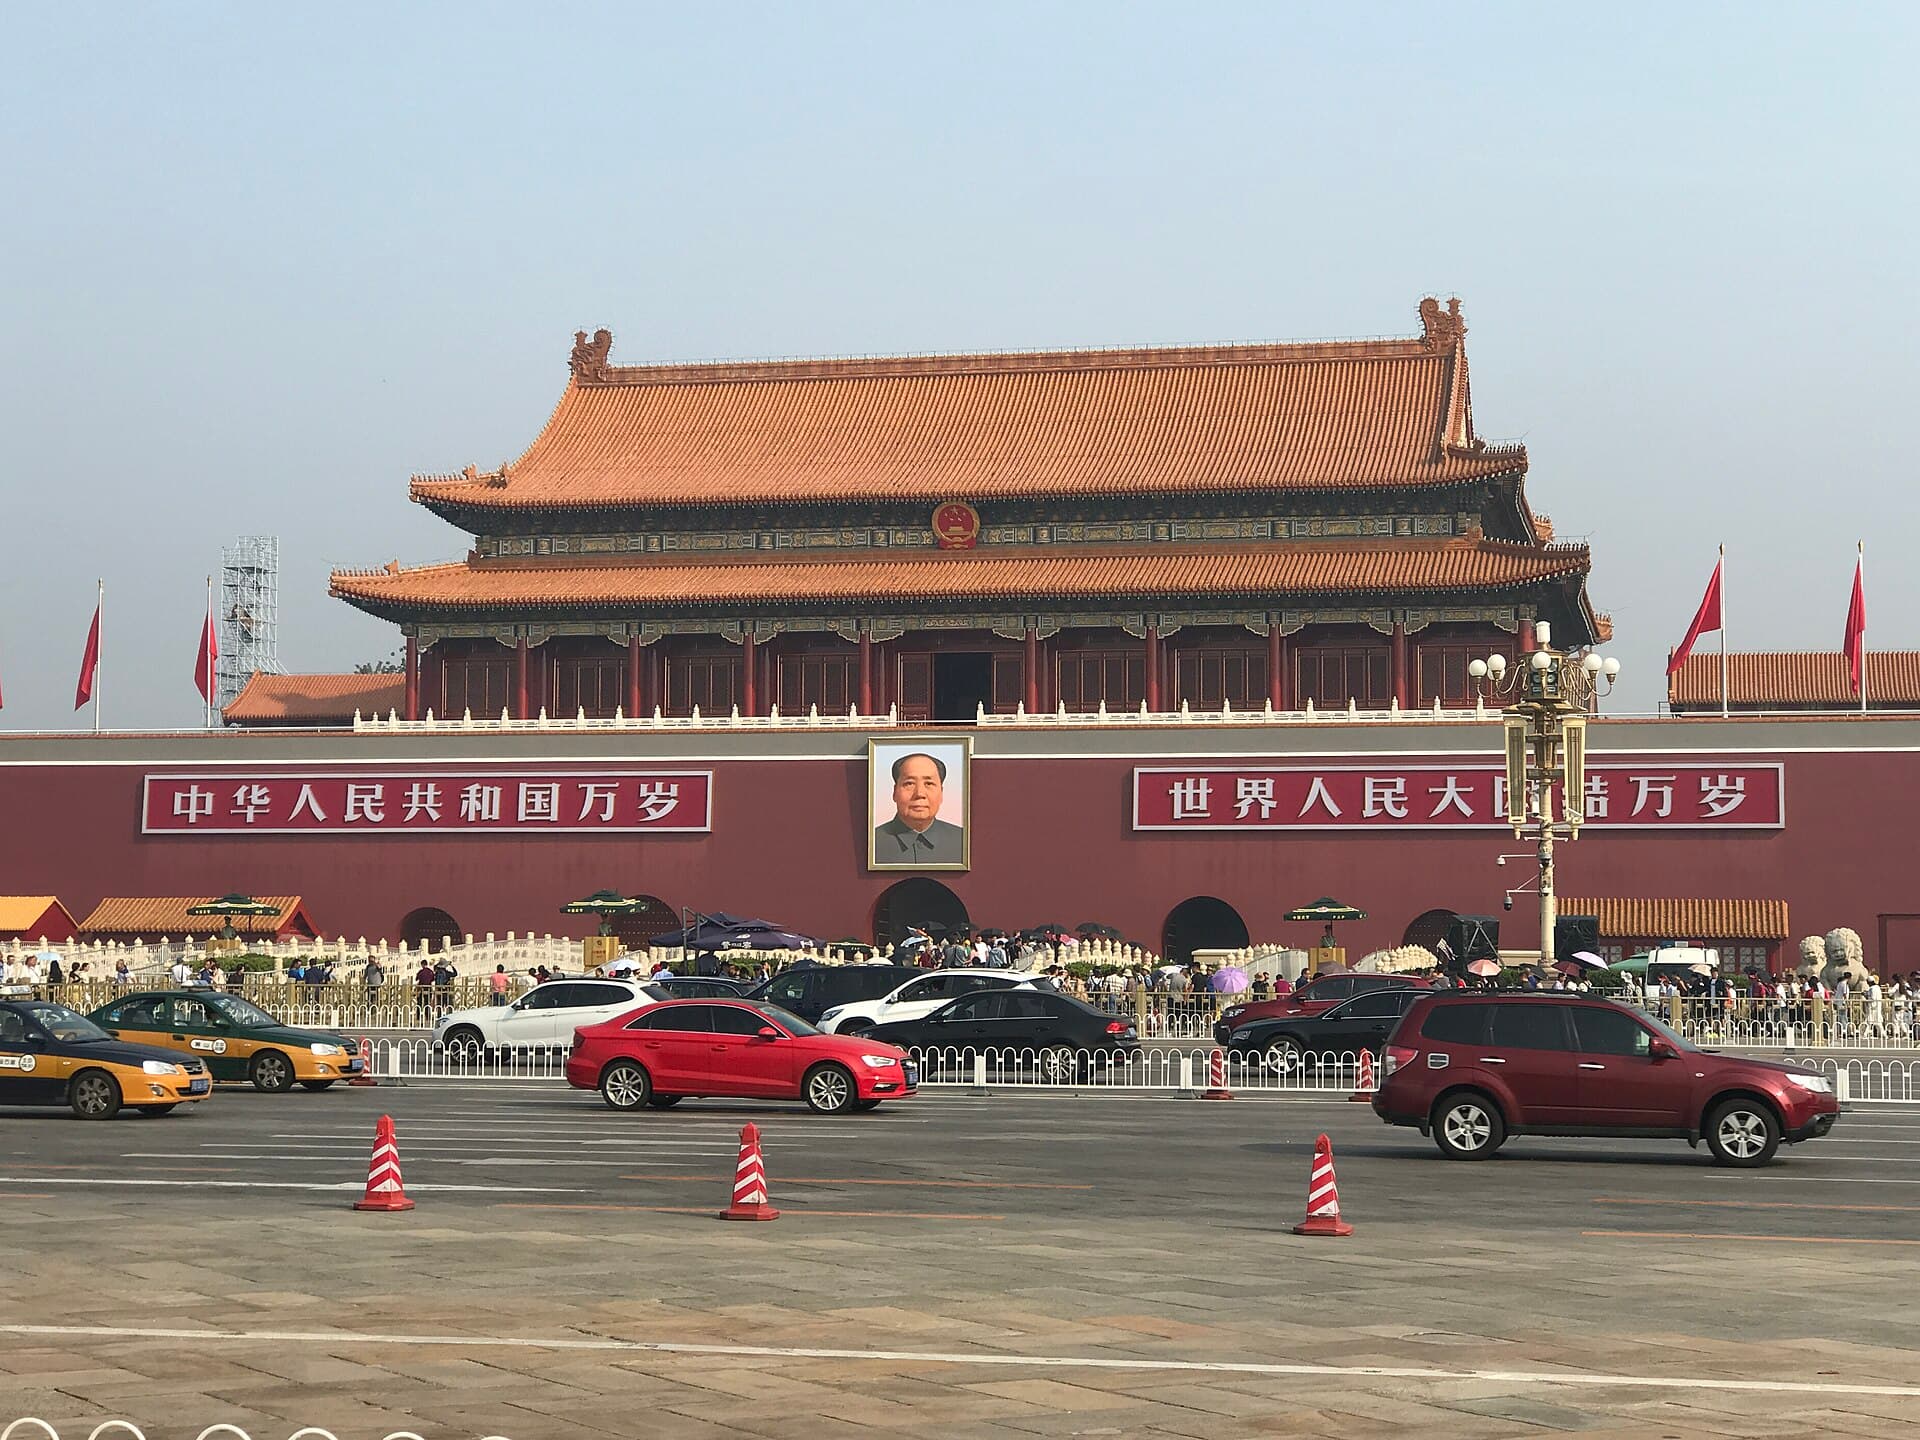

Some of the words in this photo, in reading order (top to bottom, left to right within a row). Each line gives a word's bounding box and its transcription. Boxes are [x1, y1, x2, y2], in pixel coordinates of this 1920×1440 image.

[173, 781, 680, 823] 中华人民共和国万岁
